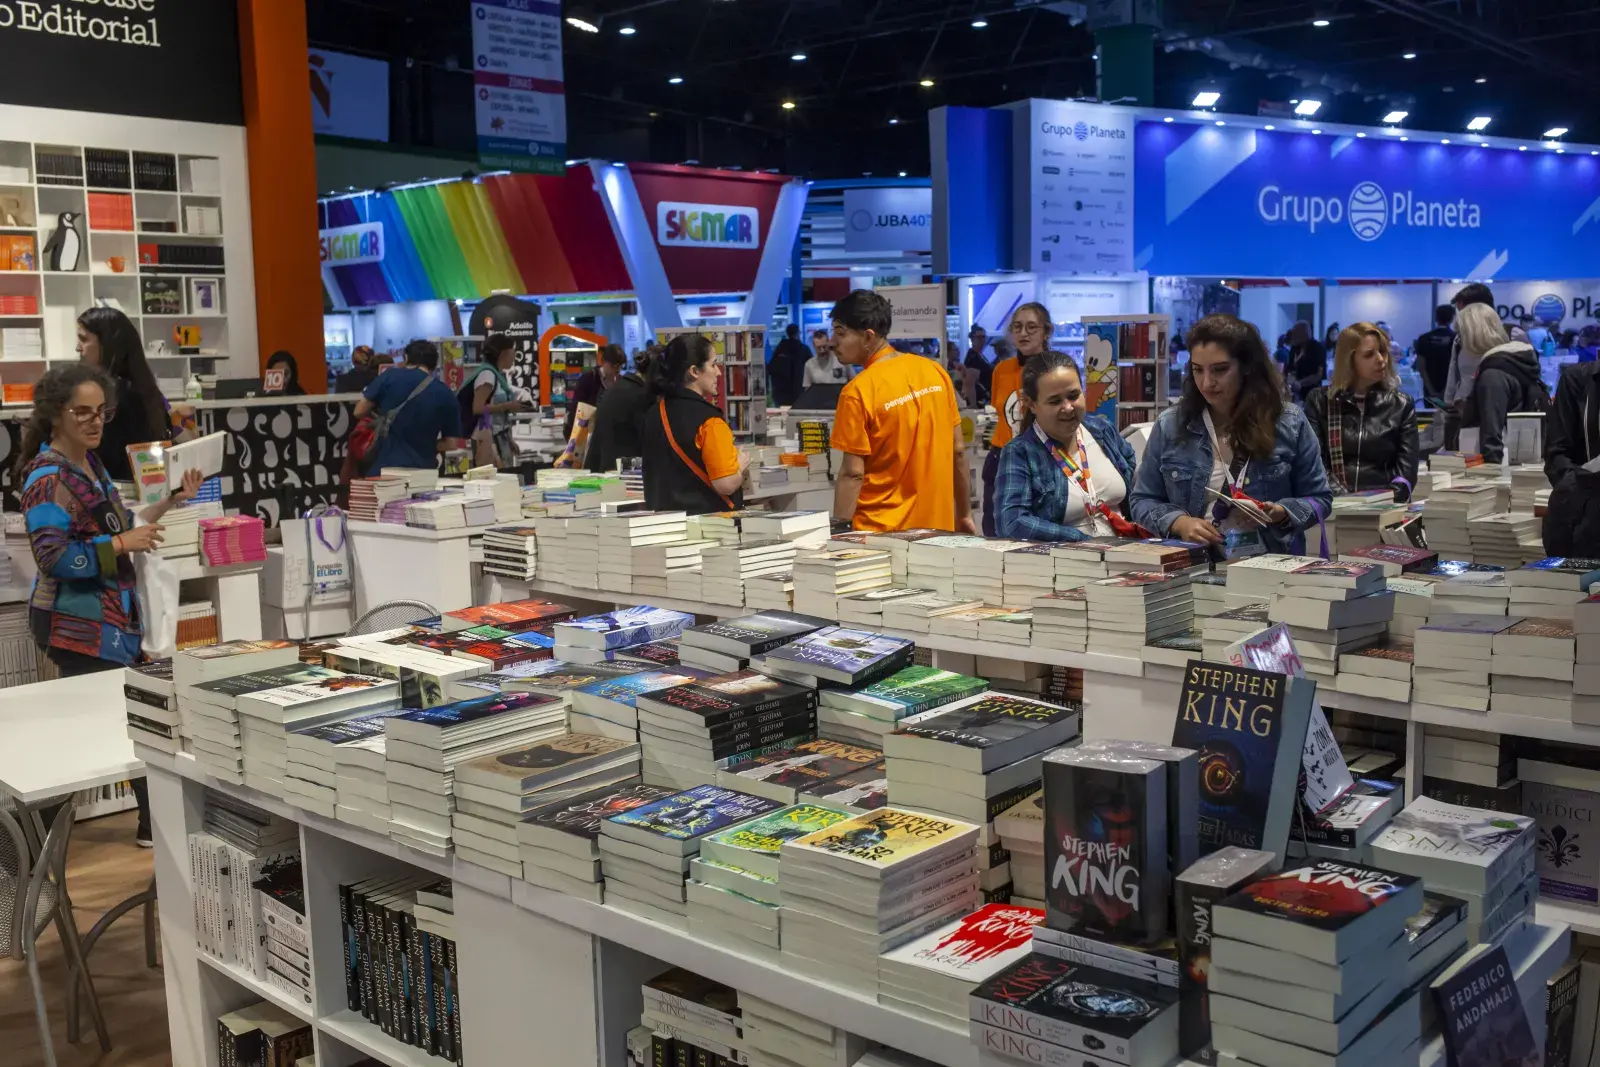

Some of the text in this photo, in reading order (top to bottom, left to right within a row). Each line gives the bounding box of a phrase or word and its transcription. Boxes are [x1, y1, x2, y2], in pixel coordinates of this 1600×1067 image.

[15, 1, 161, 47] Editorial
[1041, 121, 1126, 139] Grupo Planeta
[1258, 186, 1481, 233] Grupo Planeta
[665, 208, 753, 244] SIGMAR
[318, 229, 380, 262] SIGMAR
[892, 304, 938, 316] salamandra
[509, 321, 533, 330] Adolfo
[265, 372, 283, 386] 10
[1189, 666, 1278, 699] STEPHEN
[729, 701, 781, 721] JOHN GRISHAM
[909, 690, 969, 716] JOHN GRISHAM
[967, 703, 1050, 721] KING
[1182, 689, 1274, 737] KING
[733, 711, 783, 731] JOHN GRISHAM
[735, 721, 784, 742] JOHN GRISHAM
[736, 732, 784, 752] JOHN GRISHAM
[906, 726, 993, 746] VISITANTE
[731, 752, 752, 766] JOHN
[880, 811, 955, 831] STEPHEN
[1528, 800, 1592, 822] MEDICI
[873, 815, 945, 840] KING
[1062, 834, 1131, 866] STEPHEN
[1052, 853, 1140, 912] KING
[1279, 866, 1404, 900] KING
[1317, 861, 1399, 883] STEPHEN
[265, 897, 285, 916] KING
[272, 927, 293, 946] KING
[970, 918, 1035, 940] KING
[1193, 904, 1212, 946] KING
[272, 942, 293, 961] KING
[355, 905, 372, 999] JOHN GRISHAM
[1056, 931, 1096, 951] KING
[272, 957, 293, 977] KING
[367, 911, 383, 1008] JOHN GRISHAM
[376, 915, 390, 1012] JOHN GRISHAM
[387, 933, 395, 981] GRISHAM
[392, 921, 406, 1019] JOHN GRISHAM
[419, 945, 427, 994] GRISHAM
[912, 949, 975, 971] CARRIE
[271, 974, 293, 994] KING
[411, 926, 424, 1024] JOHN GRISHAM
[429, 932, 442, 1031] JOHN GRISHAM
[436, 936, 449, 1036] JOHN GRISHAM
[993, 960, 1070, 1003] KING
[1449, 963, 1506, 1012] FEDERICO
[447, 943, 461, 1044] JOHN GRISHAM
[658, 1001, 687, 1020] KING
[984, 1004, 1042, 1036] KING
[1455, 985, 1513, 1033] ANDAHAZI
[985, 1028, 1042, 1063] KING
